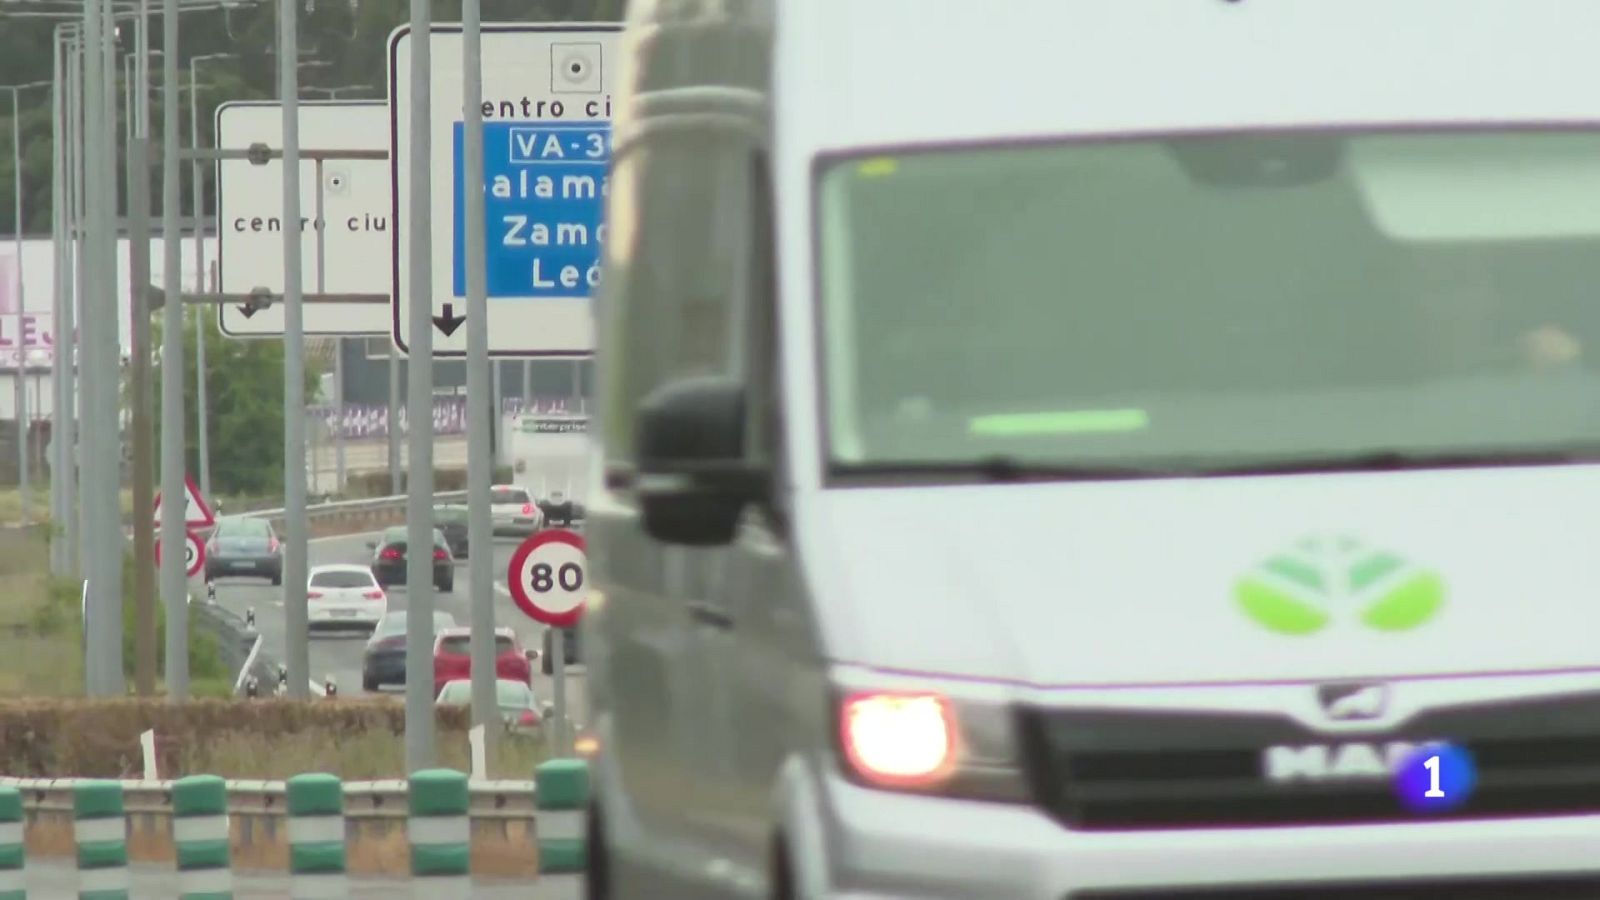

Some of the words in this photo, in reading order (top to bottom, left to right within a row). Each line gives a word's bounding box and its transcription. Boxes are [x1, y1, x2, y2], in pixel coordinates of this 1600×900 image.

[463, 97, 564, 117] entro
[586, 95, 611, 117] ci
[483, 169, 609, 198] alam
[234, 216, 326, 232] cenro
[347, 213, 386, 231] ciu
[530, 562, 583, 592] 80
